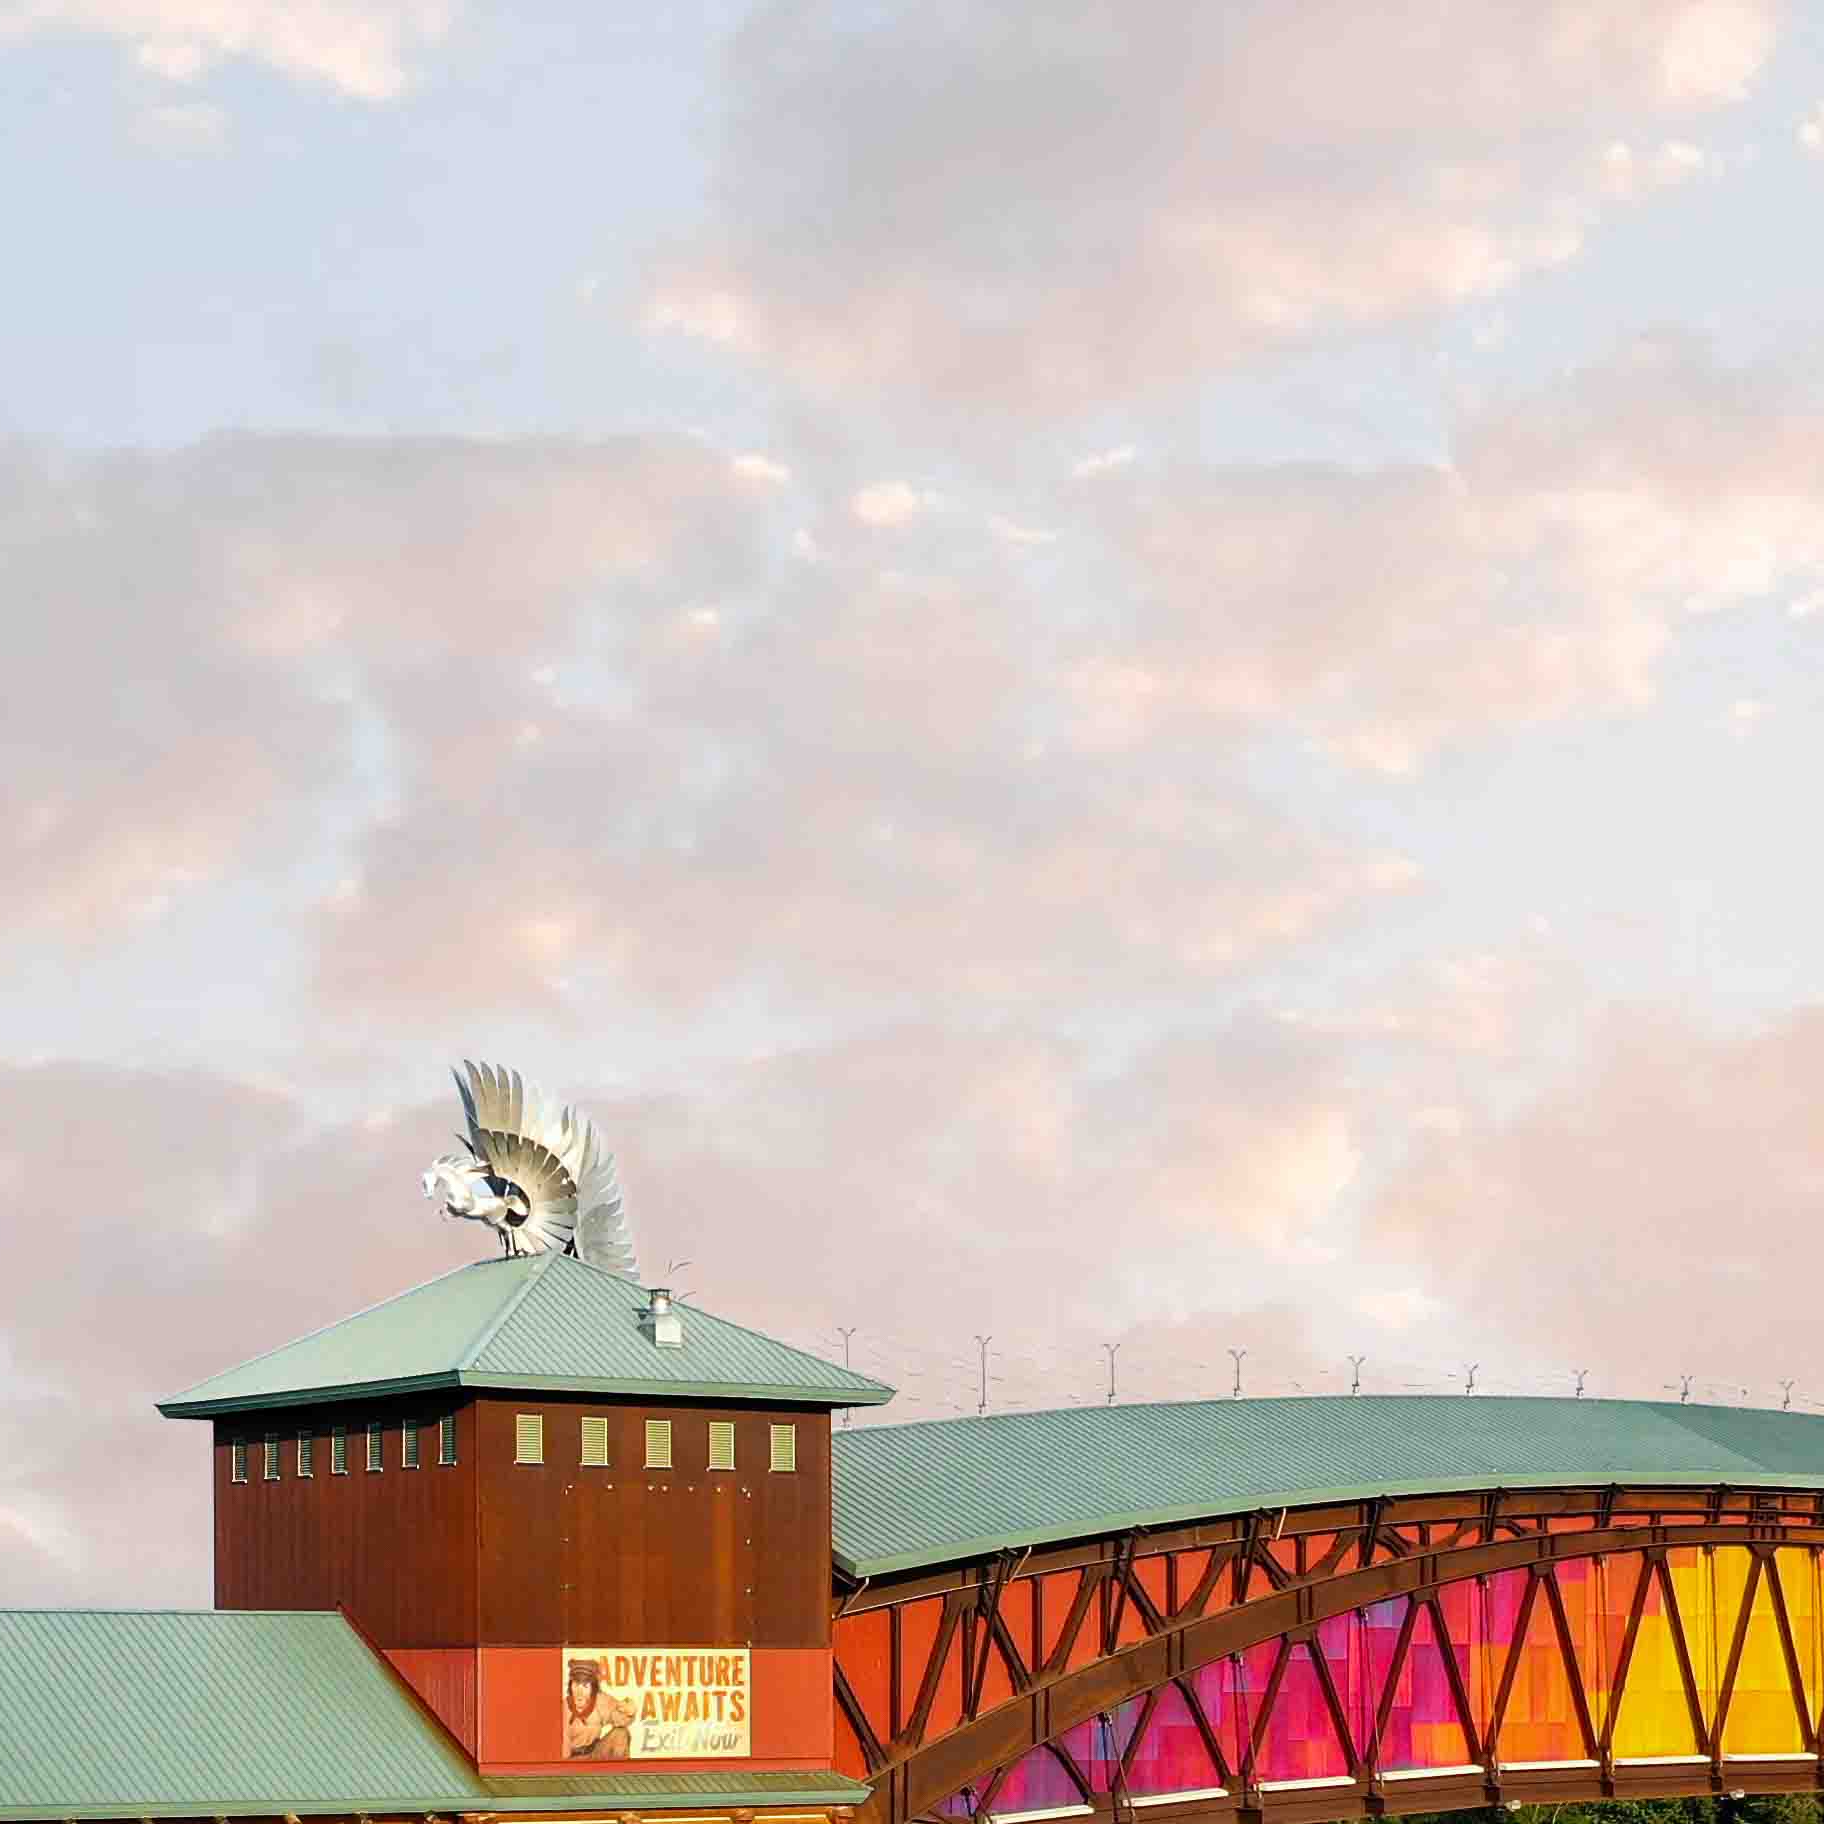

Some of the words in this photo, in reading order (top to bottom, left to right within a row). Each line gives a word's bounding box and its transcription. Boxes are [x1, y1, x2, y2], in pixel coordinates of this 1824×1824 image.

[597, 1655, 745, 1687] ADVENTURE
[640, 1691, 745, 1723] AWAITS
[693, 1727, 741, 1752] Now
